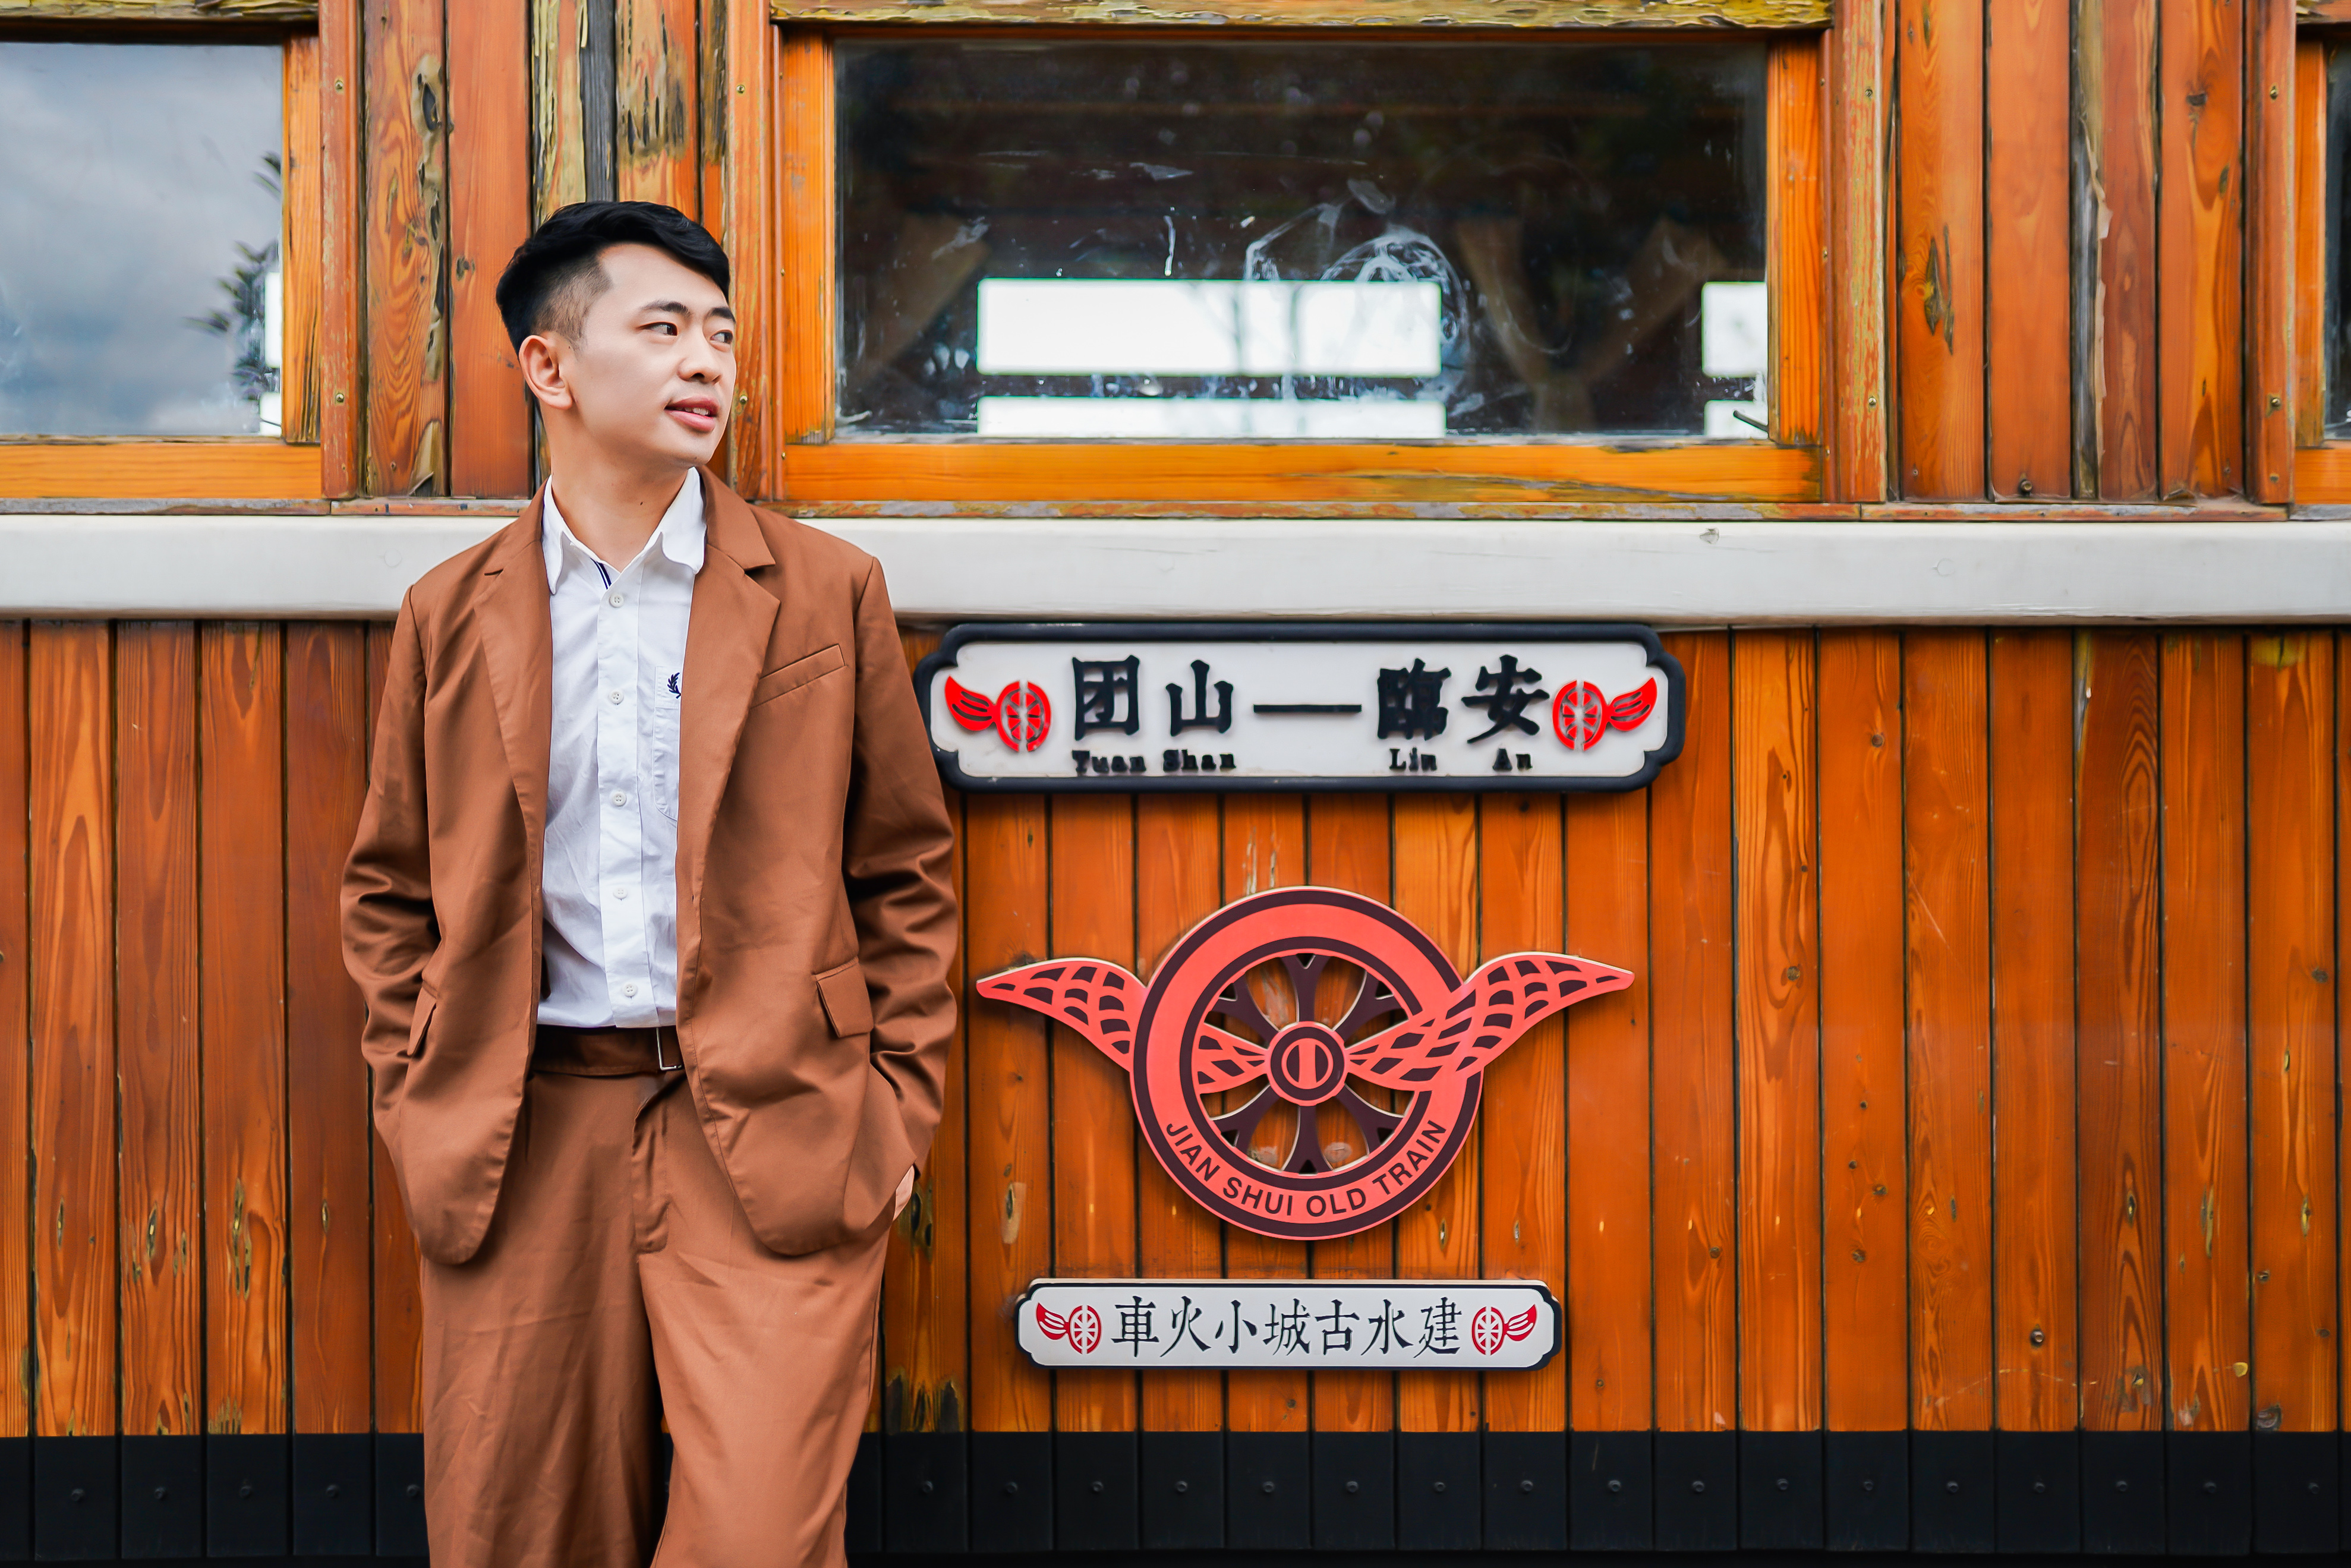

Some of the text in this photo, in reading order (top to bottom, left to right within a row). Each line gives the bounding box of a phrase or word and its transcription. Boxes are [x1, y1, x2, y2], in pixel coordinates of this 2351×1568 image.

[1162, 749, 1237, 773] Shan
[1389, 747, 1438, 772] Lin
[1492, 748, 1533, 772] An
[1166, 1119, 1447, 1217] JIAN SHUI OLD TRAIN
